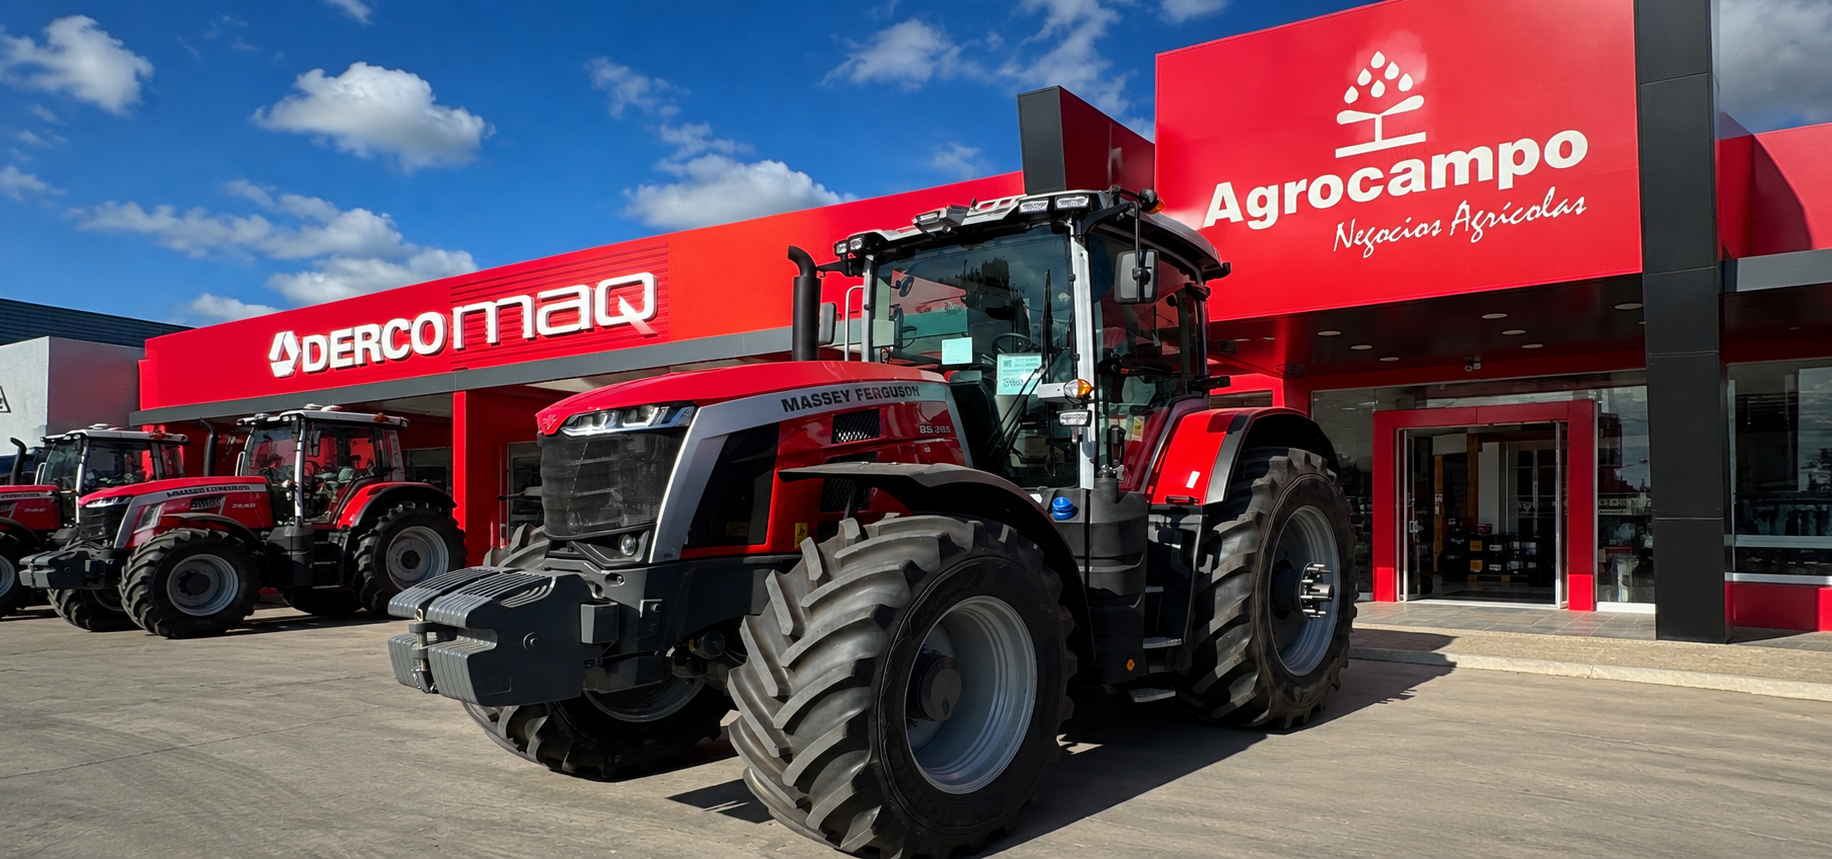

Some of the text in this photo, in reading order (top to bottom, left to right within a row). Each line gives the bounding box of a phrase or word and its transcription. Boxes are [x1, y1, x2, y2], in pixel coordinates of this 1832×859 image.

[1203, 129, 1589, 230] Agrocampo
[1333, 185, 1587, 259] Negocios Agrícolas
[780, 385, 921, 413] MASSEY FERGUSON
